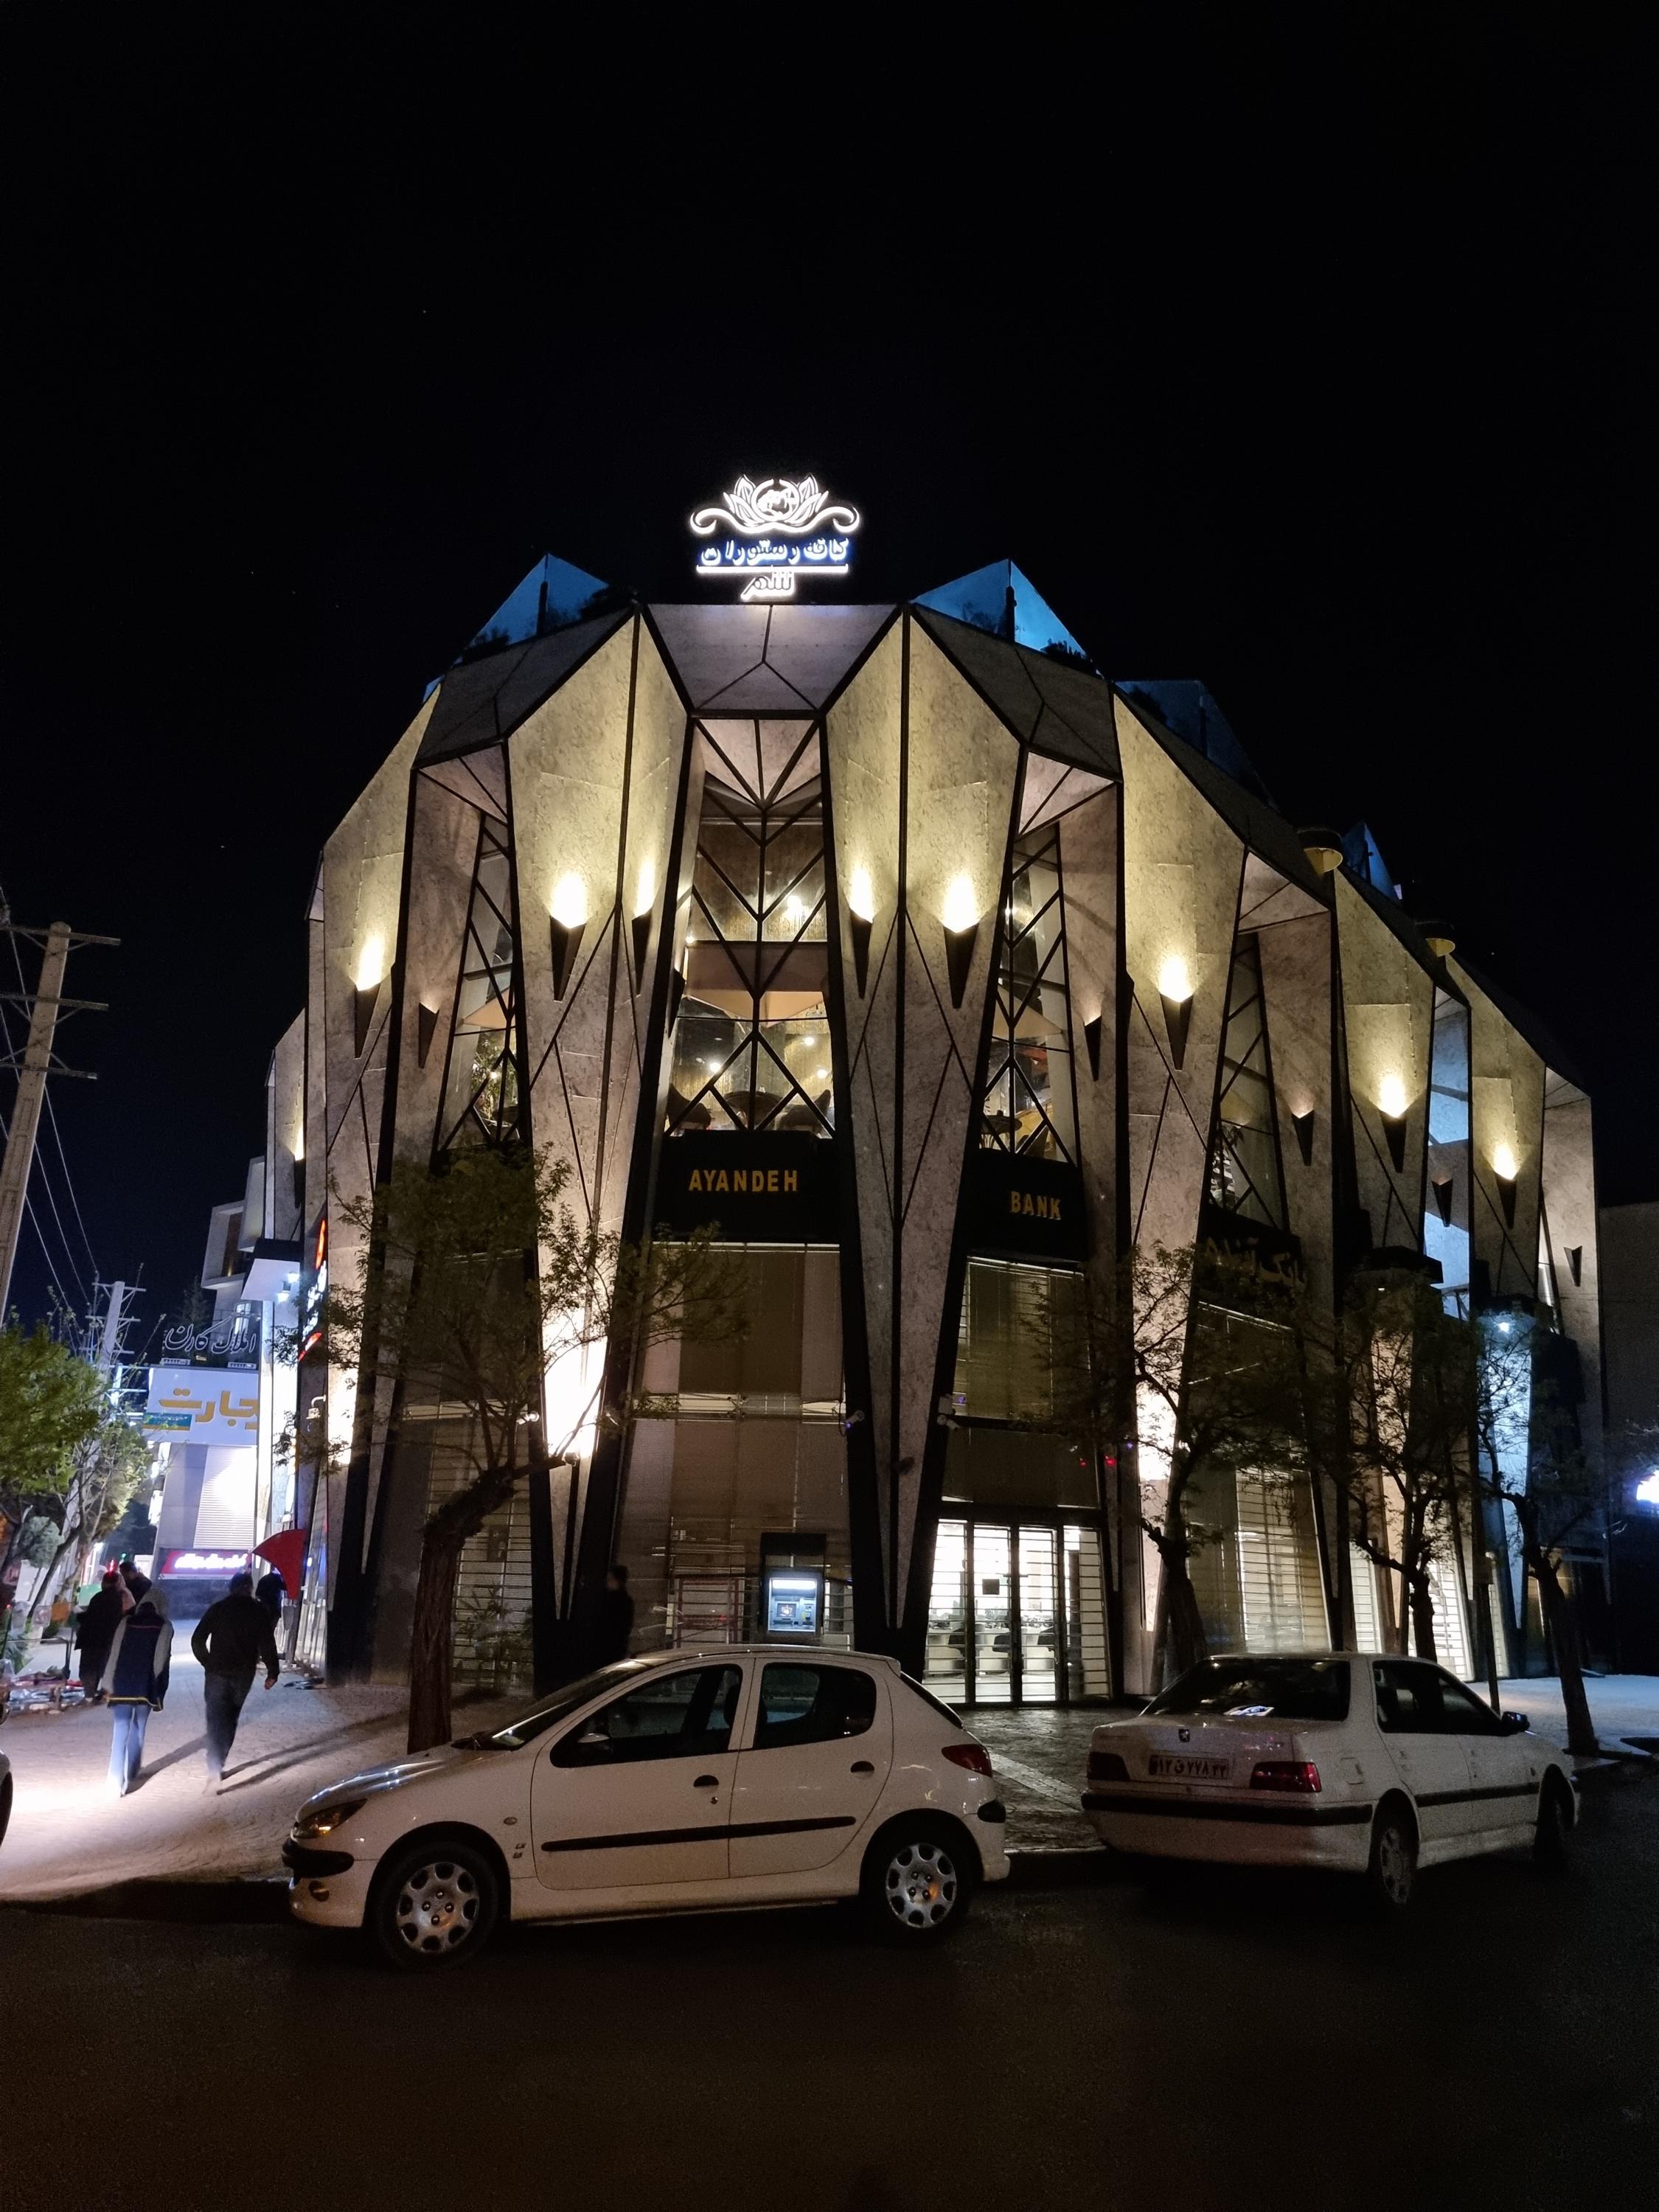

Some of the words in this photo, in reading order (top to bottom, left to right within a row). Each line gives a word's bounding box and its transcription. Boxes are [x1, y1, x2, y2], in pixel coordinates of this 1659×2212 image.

[701, 540, 801, 566] رستوران
[689, 1169, 799, 1192] AYANDEH
[1010, 1190, 1062, 1220] BANK
